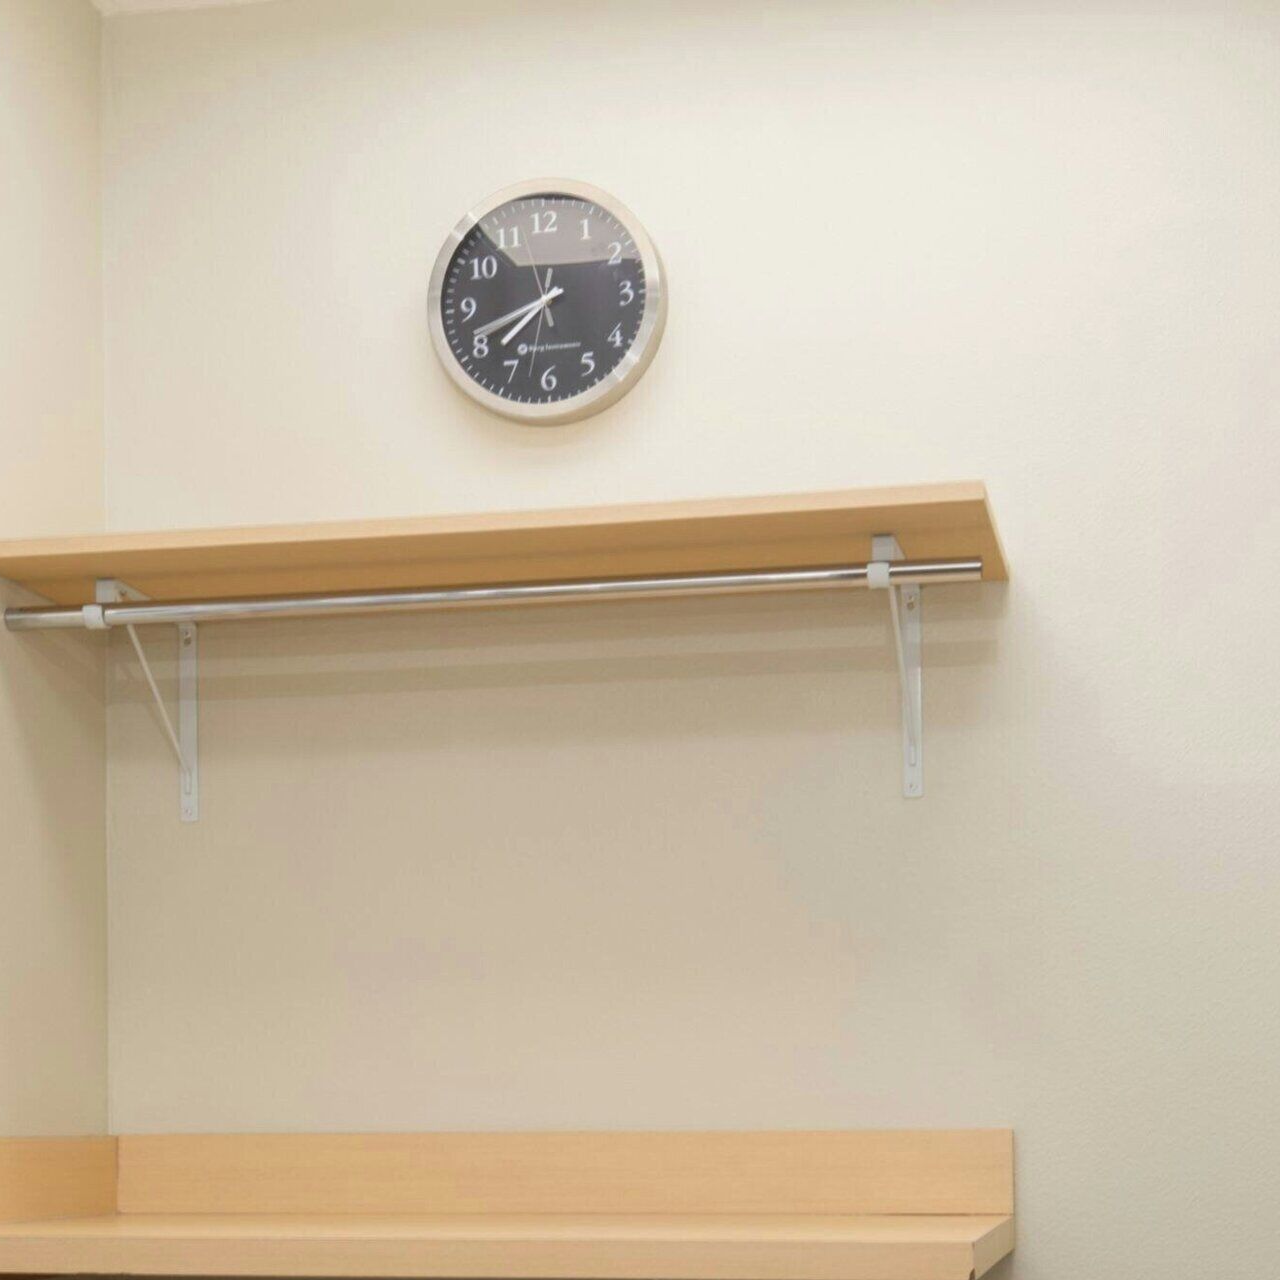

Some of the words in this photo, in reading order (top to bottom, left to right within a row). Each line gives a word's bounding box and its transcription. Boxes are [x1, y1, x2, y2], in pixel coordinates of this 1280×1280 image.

[531, 210, 558, 235] 12
[580, 219, 592, 240] 1
[496, 227, 522, 250] 11
[607, 242, 622, 265] 2
[469, 255, 498, 281] 10
[618, 280, 634, 307] 3
[460, 297, 476, 324] 9
[472, 334, 489, 359] 8
[607, 322, 623, 348] 4
[503, 359, 519, 384] 7
[580, 351, 596, 377] 5
[540, 365, 557, 392] 6
